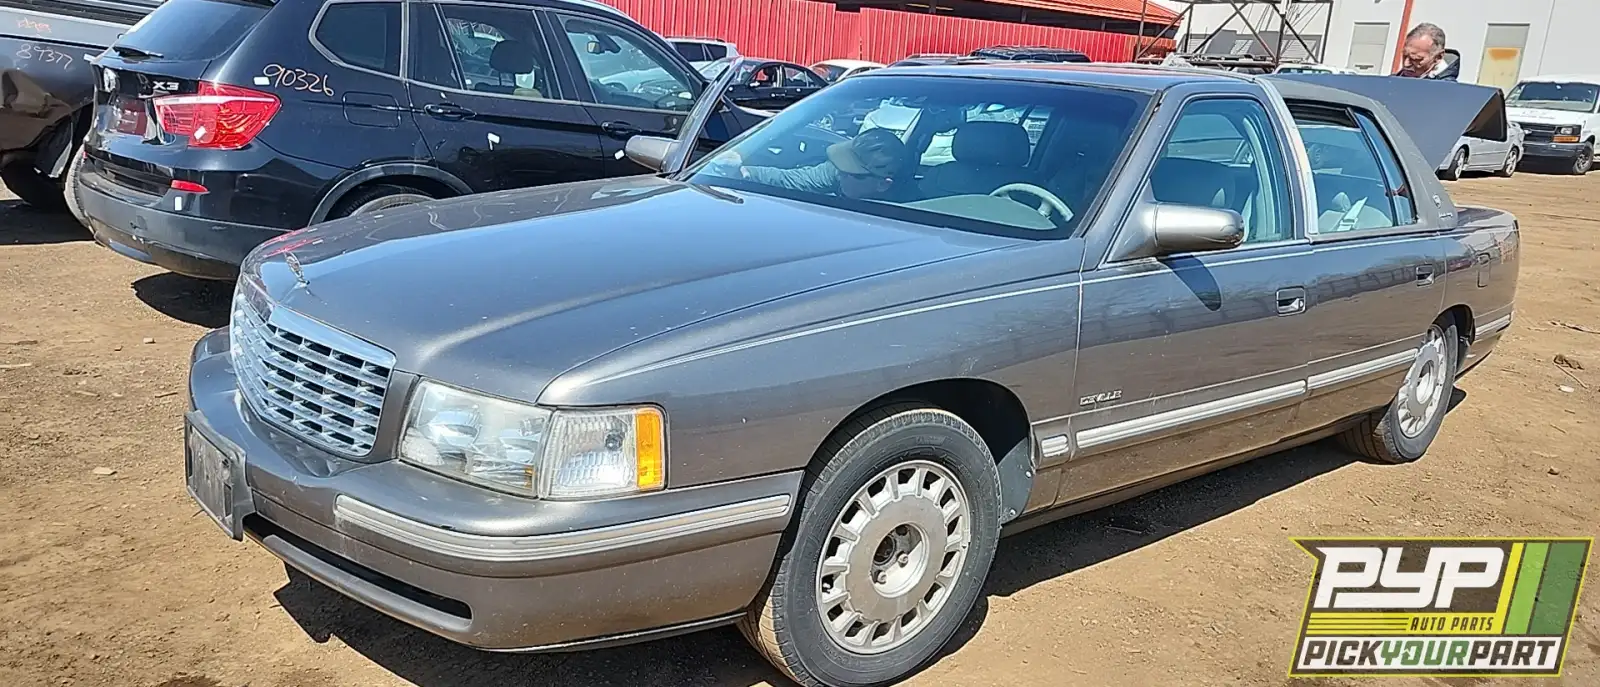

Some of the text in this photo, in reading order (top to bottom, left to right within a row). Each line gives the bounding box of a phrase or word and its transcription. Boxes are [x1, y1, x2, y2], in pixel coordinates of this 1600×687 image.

[16, 43, 73, 70] 89377
[152, 81, 180, 91] X3
[263, 63, 335, 97] 90326
